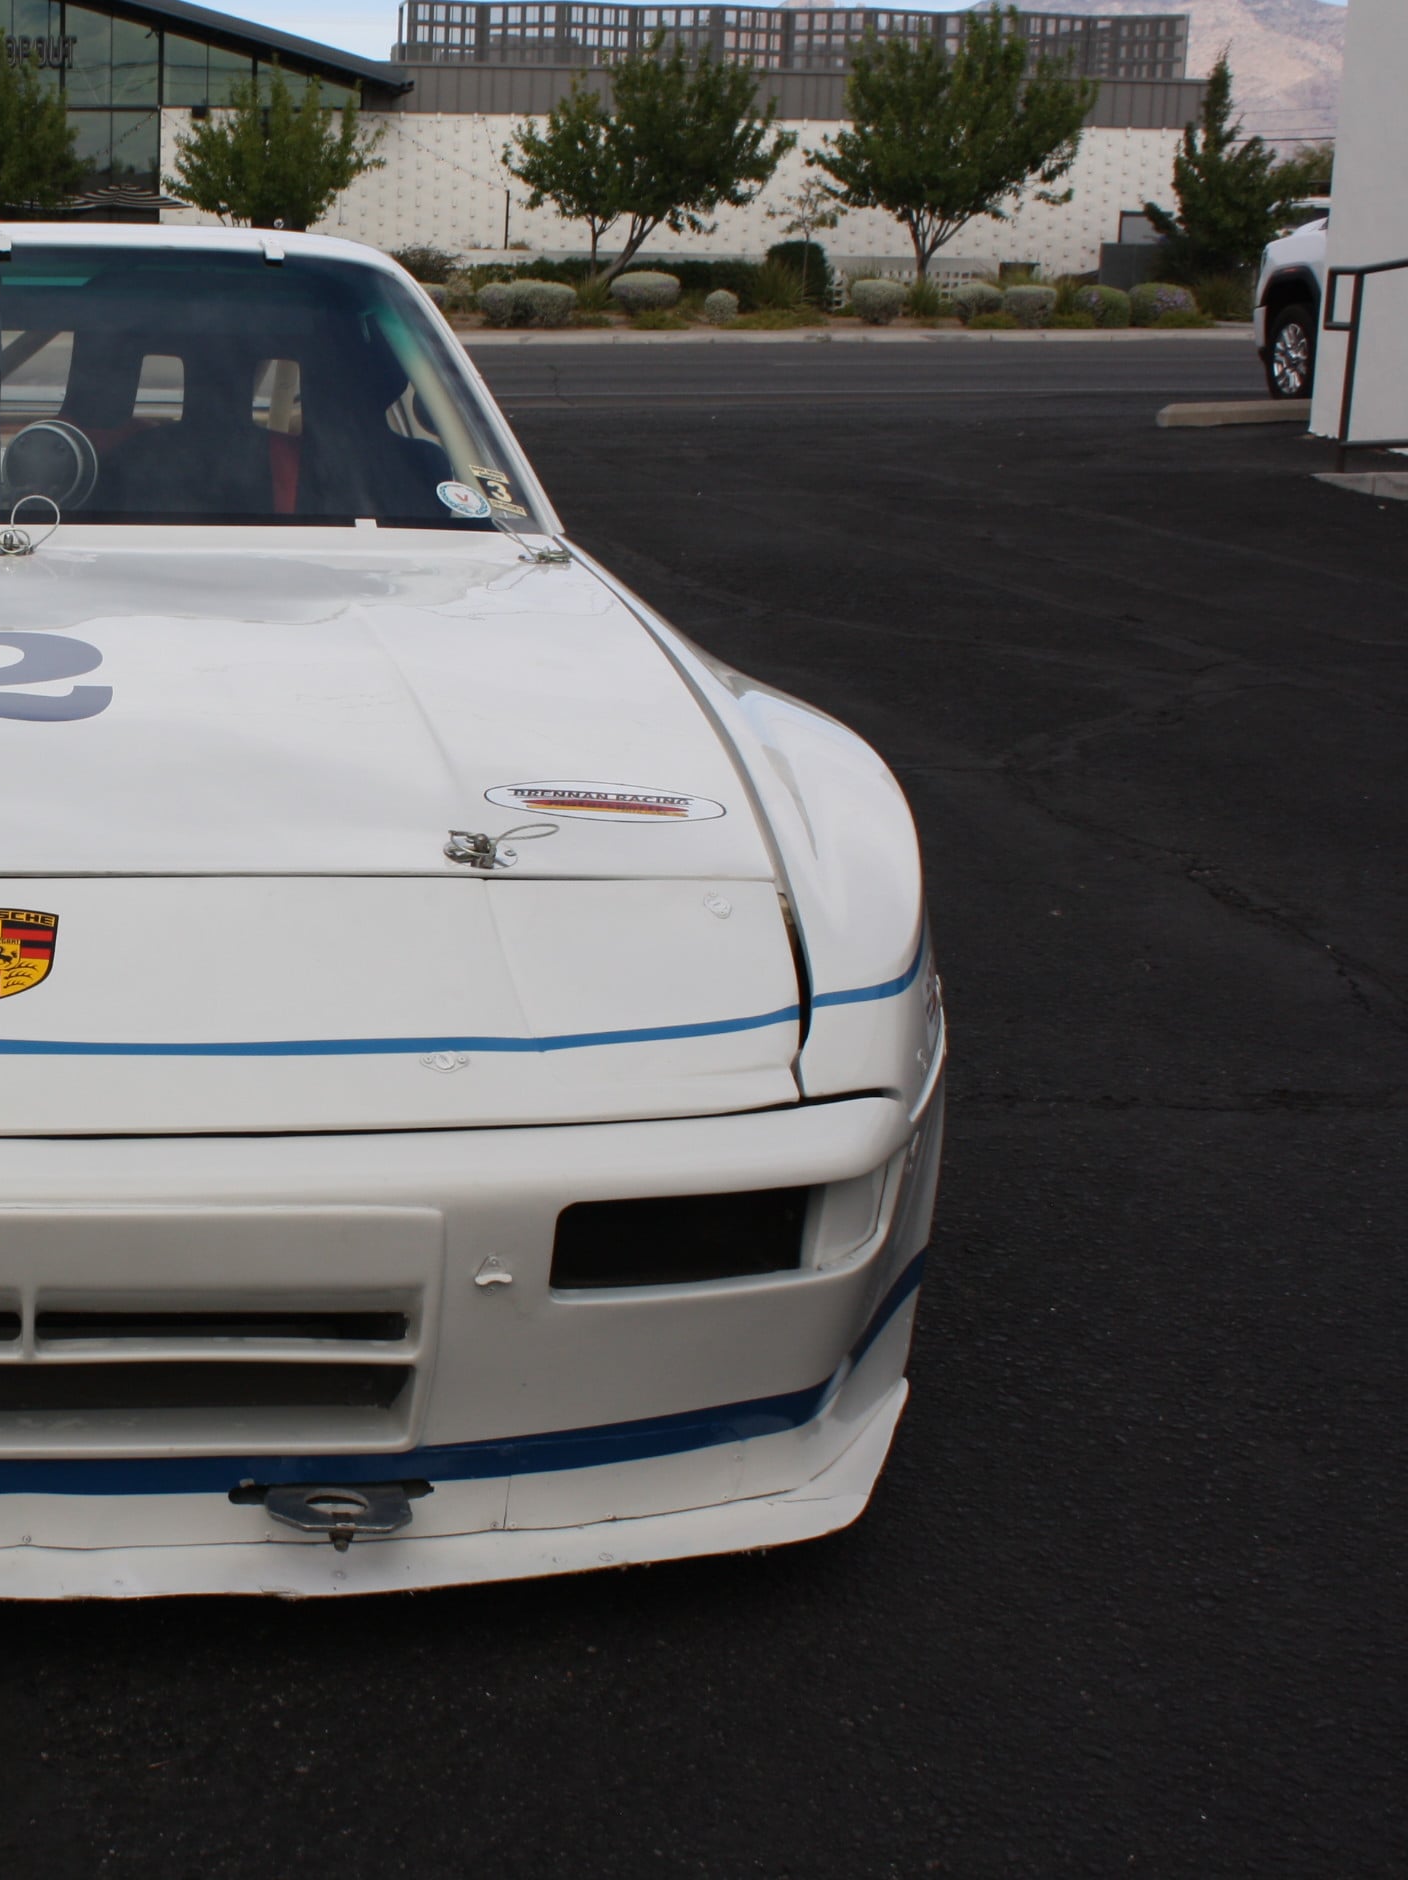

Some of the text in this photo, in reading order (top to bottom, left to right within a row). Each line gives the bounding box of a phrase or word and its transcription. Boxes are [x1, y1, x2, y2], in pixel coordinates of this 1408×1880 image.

[487, 480, 513, 502] 3
[508, 788, 692, 805] BRENNAN RACING
